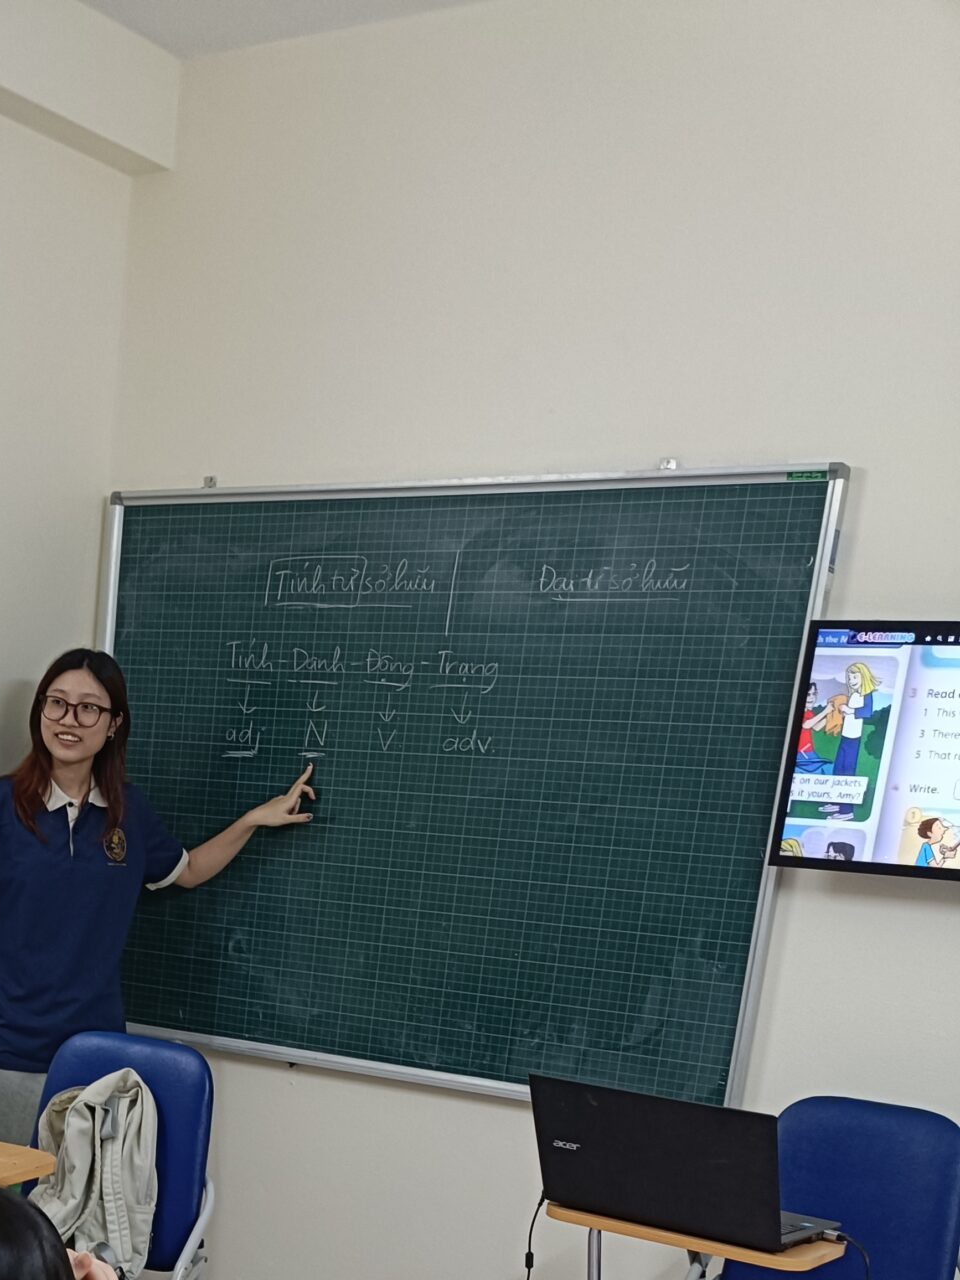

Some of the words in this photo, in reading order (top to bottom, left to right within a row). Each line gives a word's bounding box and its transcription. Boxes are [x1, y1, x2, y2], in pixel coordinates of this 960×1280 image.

[275, 561, 326, 601] Tính
[857, 631, 916, 643] E-LEARNING
[226, 637, 273, 672] Tính
[292, 645, 345, 673] Danh
[366, 648, 415, 692] Động
[438, 650, 499, 694] Trạng
[927, 688, 956, 699] Read
[937, 707, 957, 718] This
[225, 720, 266, 755] adj
[304, 720, 328, 748] N
[919, 729, 926, 739] 3
[914, 750, 921, 759] 5
[929, 749, 951, 761] That
[799, 777, 811, 785] on
[813, 778, 830, 786] our
[798, 789, 804, 797] it
[552, 1139, 582, 1151] acer
